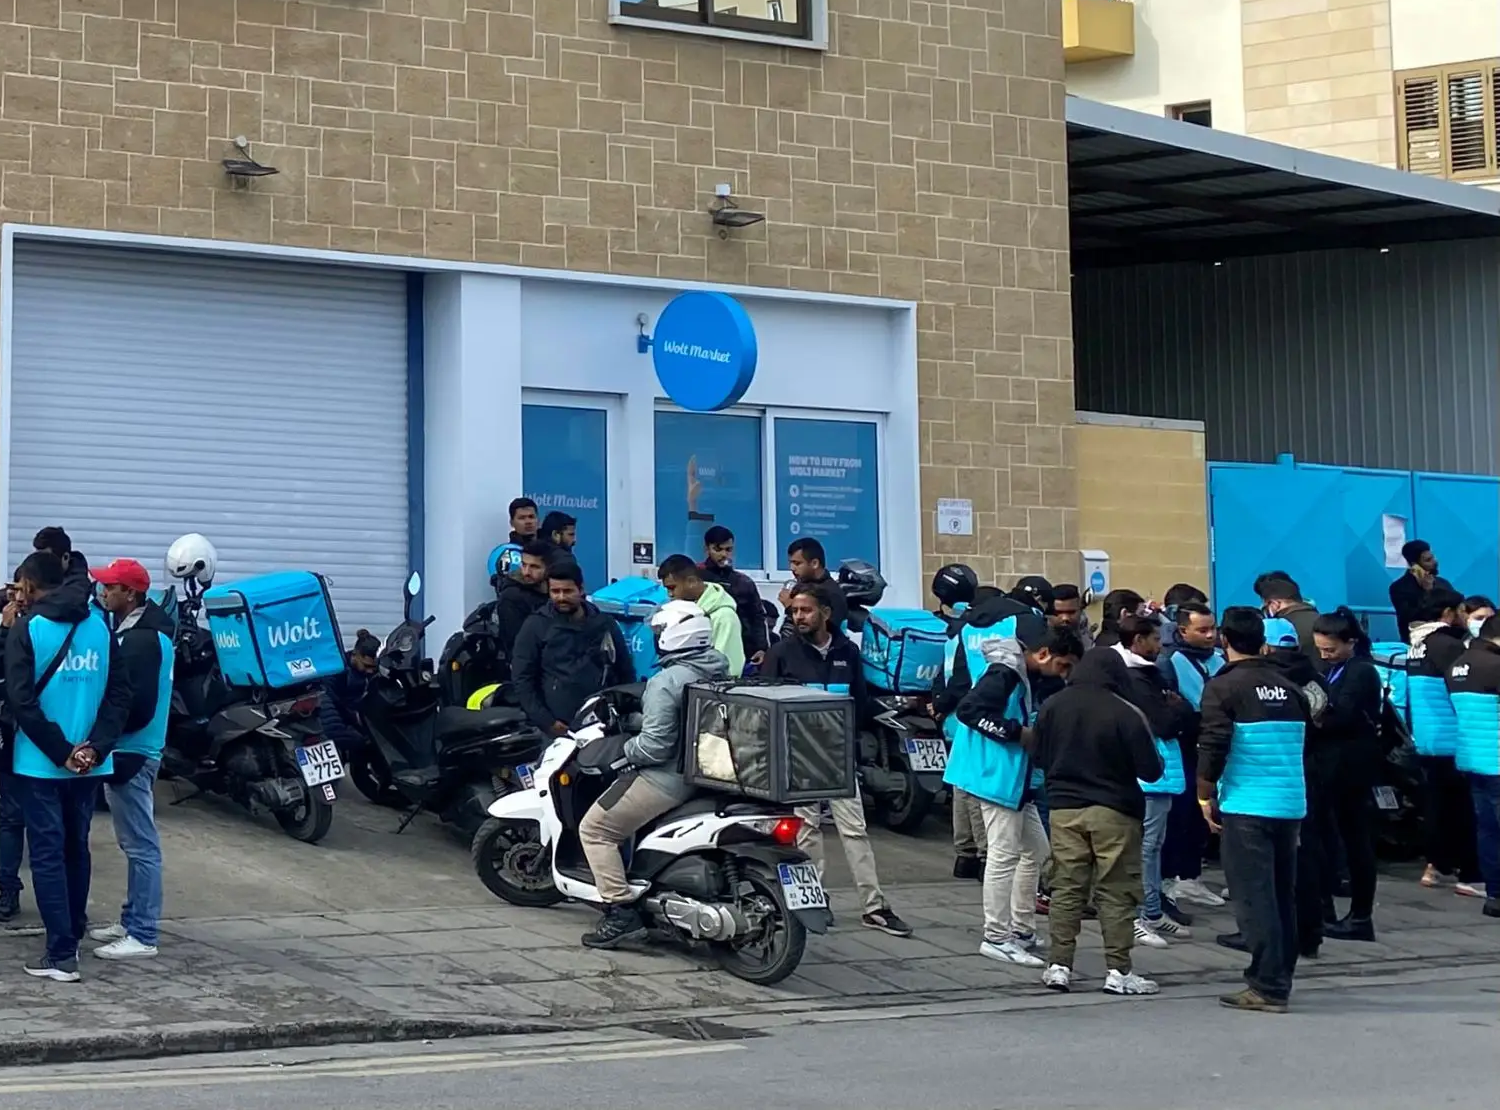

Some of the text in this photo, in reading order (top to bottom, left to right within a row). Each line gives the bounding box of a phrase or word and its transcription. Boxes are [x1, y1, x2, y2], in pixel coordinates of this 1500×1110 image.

[664, 340, 732, 363] Wolt Market
[553, 494, 598, 509] Market
[216, 630, 241, 648] Wolt
[267, 616, 322, 648] Wolt
[1255, 685, 1288, 700] Wolt
[306, 743, 336, 764] NYE
[916, 741, 945, 754] PHZ
[314, 759, 342, 780] 775
[922, 754, 947, 769] 141
[324, 785, 335, 799] E
[789, 865, 818, 884] NZN
[798, 886, 824, 905] 338
